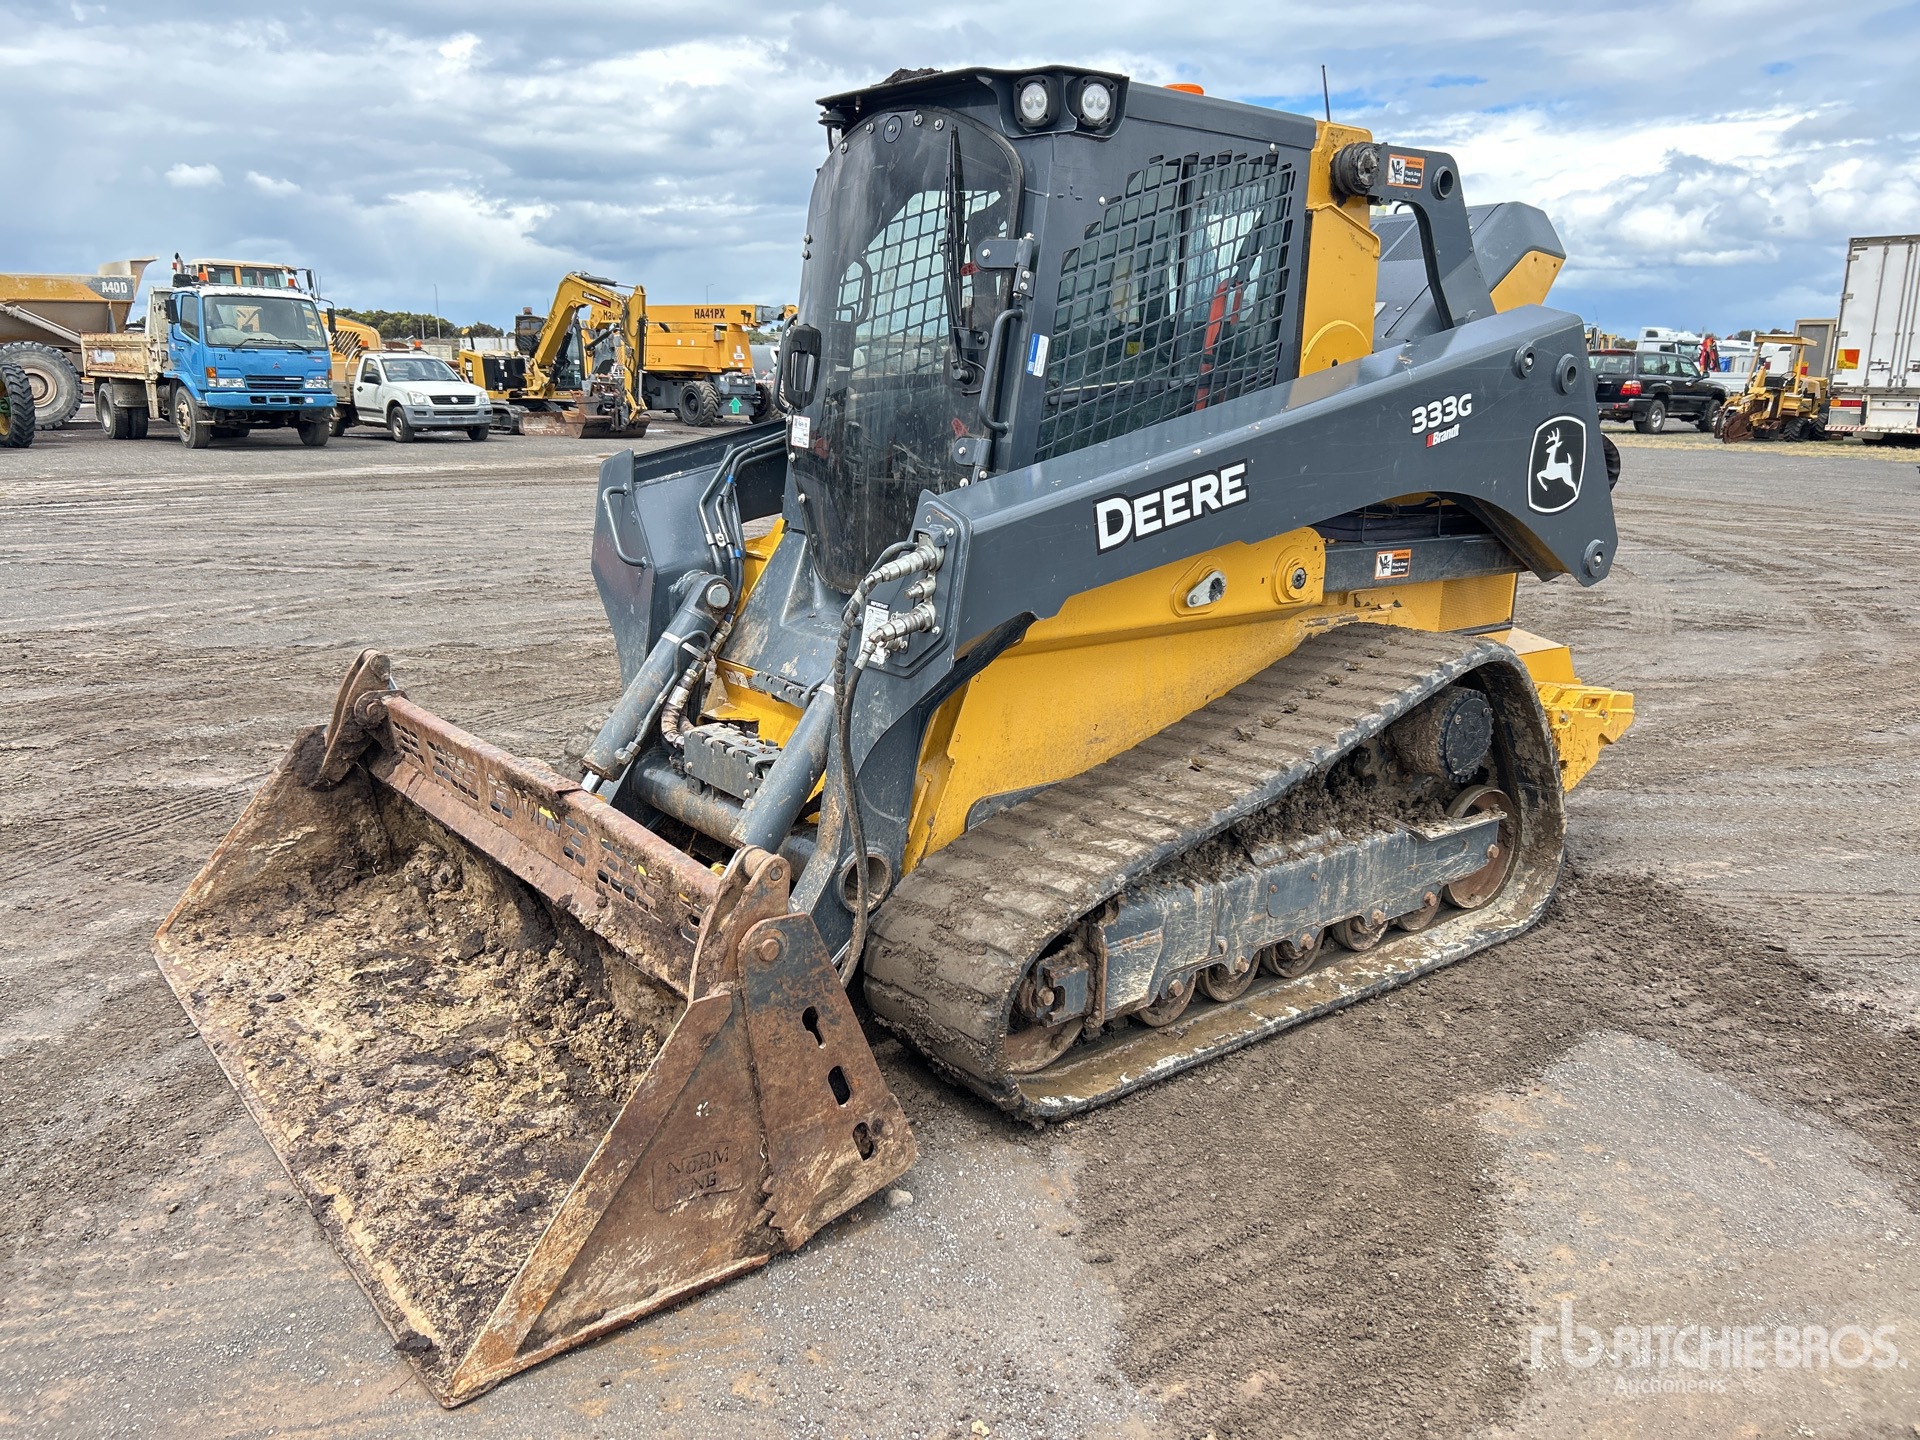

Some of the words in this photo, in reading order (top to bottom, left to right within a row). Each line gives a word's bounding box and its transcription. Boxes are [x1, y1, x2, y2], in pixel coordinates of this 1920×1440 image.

[694, 308, 726, 319] HA41PX
[1411, 393, 1473, 434] 333G
[1432, 423, 1460, 446] Brandt
[1096, 463, 1248, 551] DEERE
